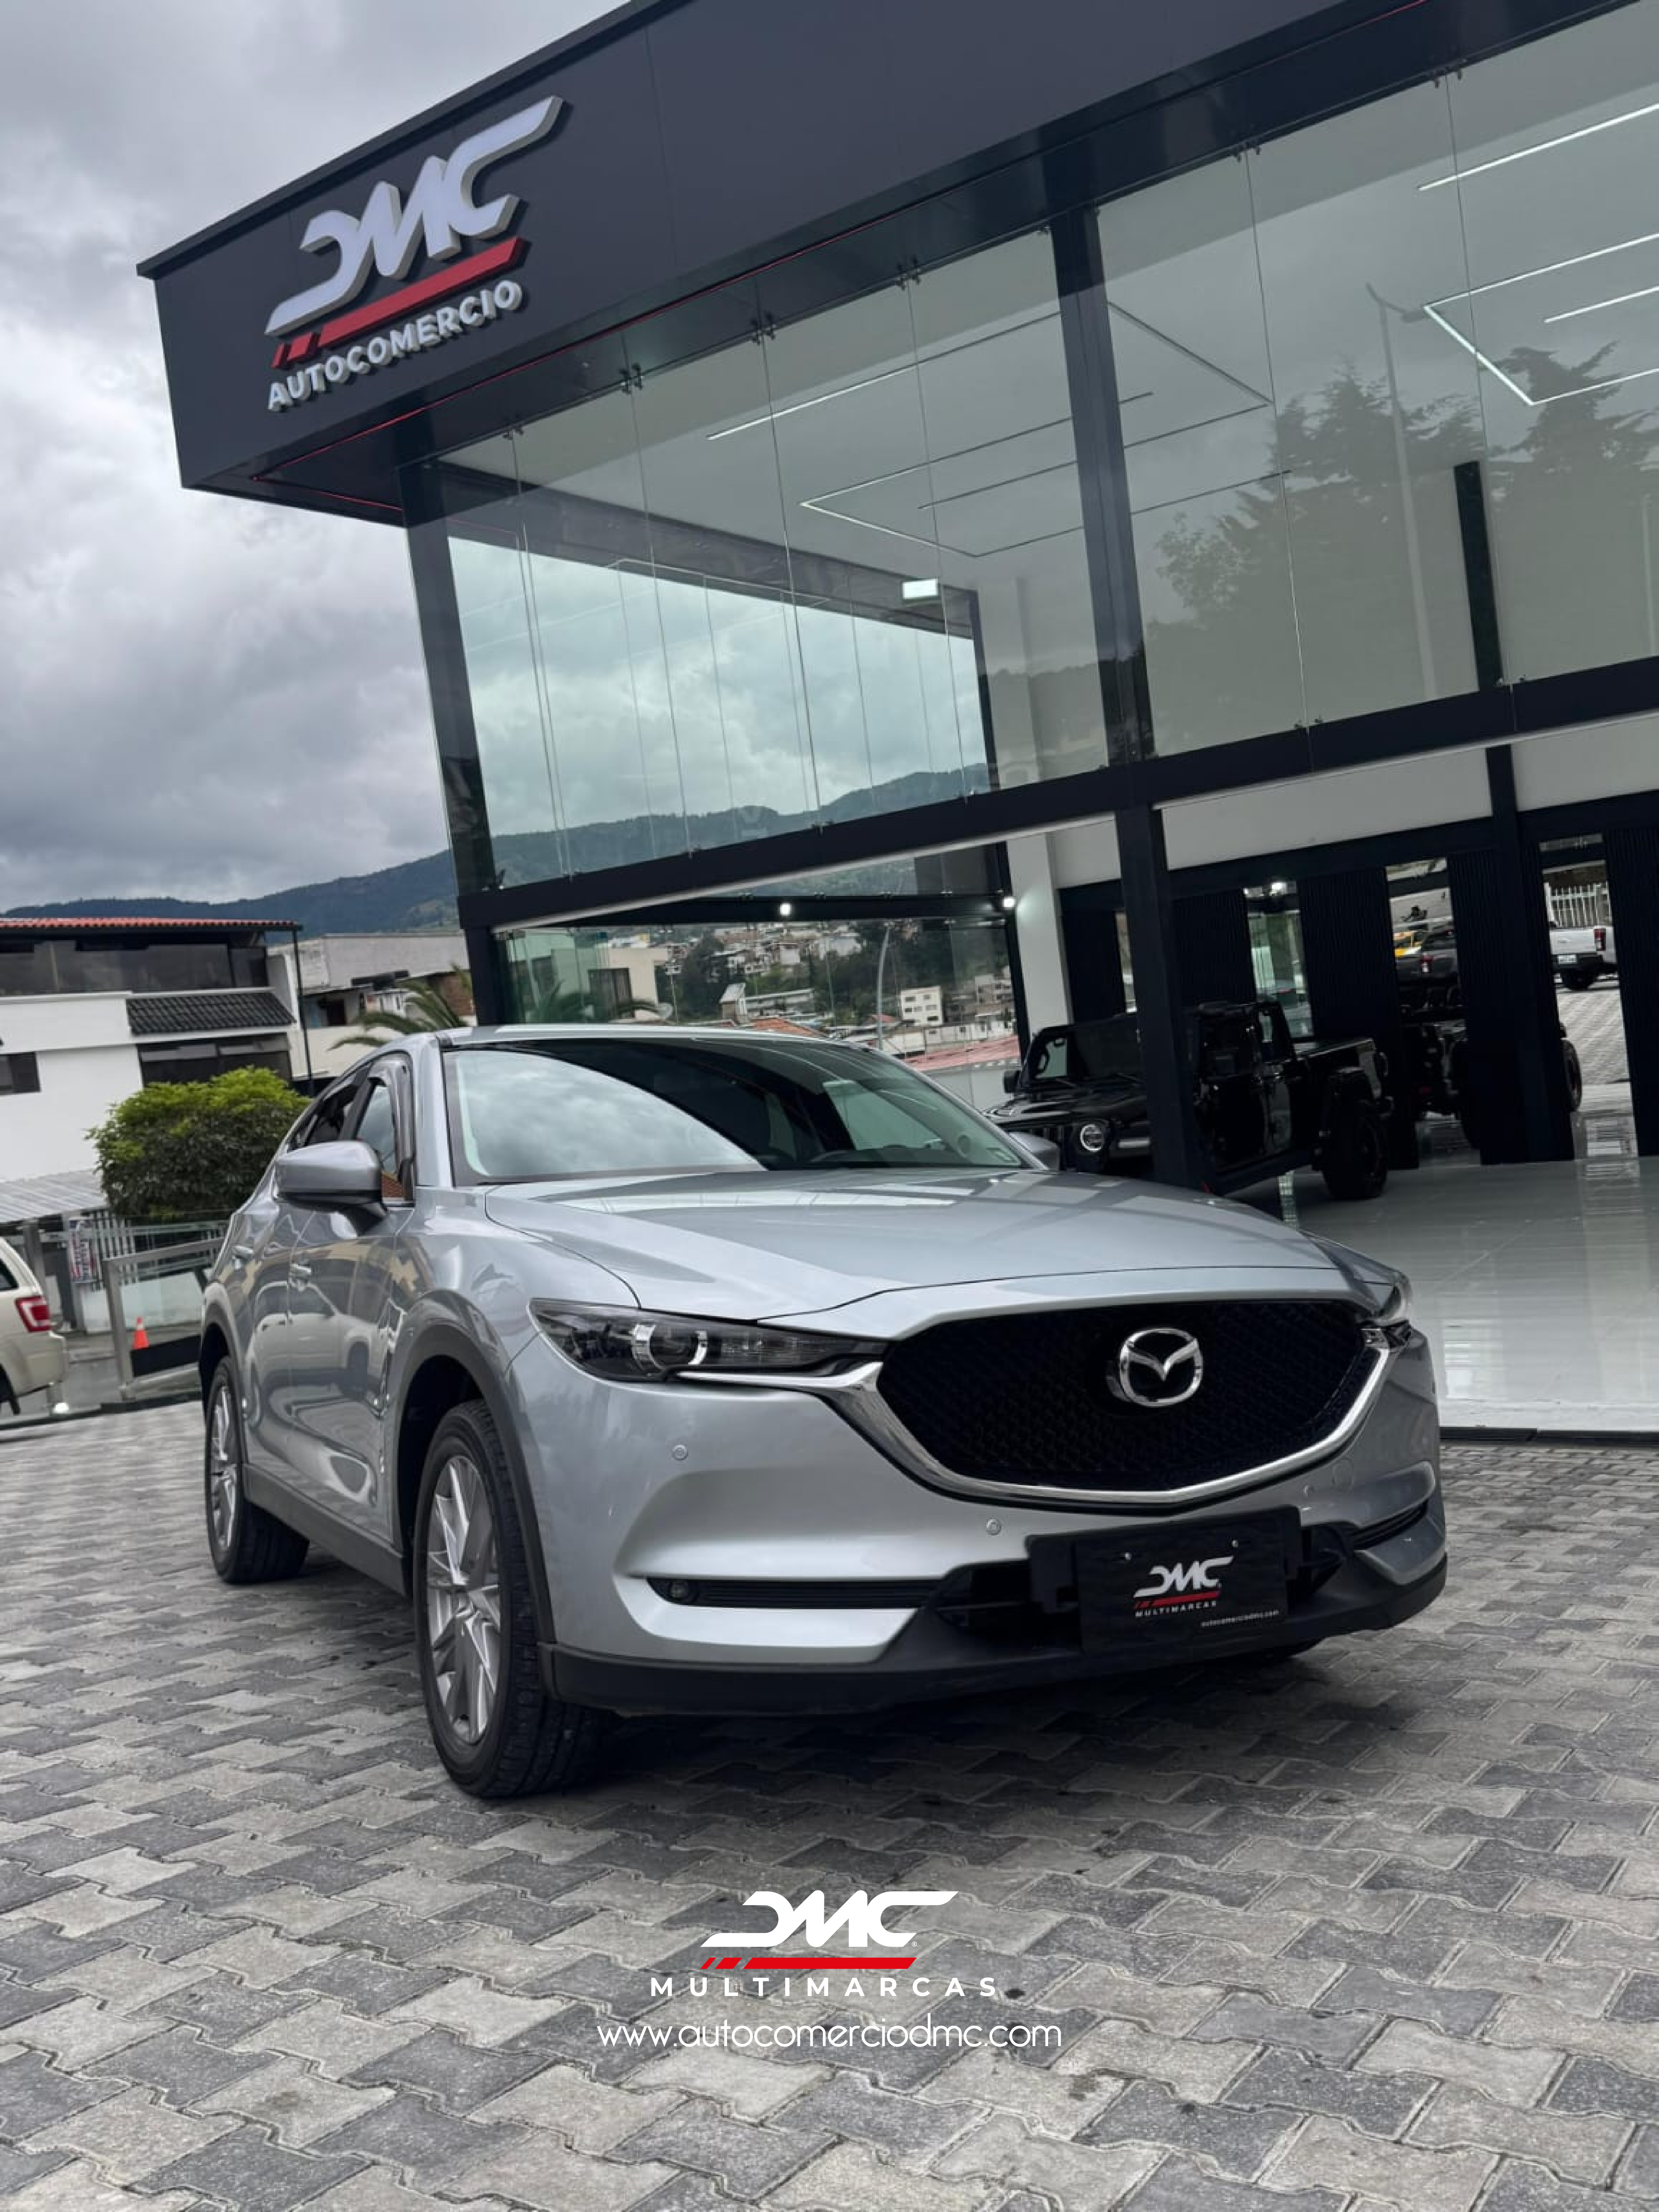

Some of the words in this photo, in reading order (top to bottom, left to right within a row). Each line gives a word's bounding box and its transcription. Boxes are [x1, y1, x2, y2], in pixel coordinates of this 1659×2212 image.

[265, 95, 563, 336] DMC
[267, 280, 523, 411] AUTOCOMERCIO
[1133, 1555, 1235, 1598] DMC
[1135, 1600, 1217, 1618] MULTIMARCAS
